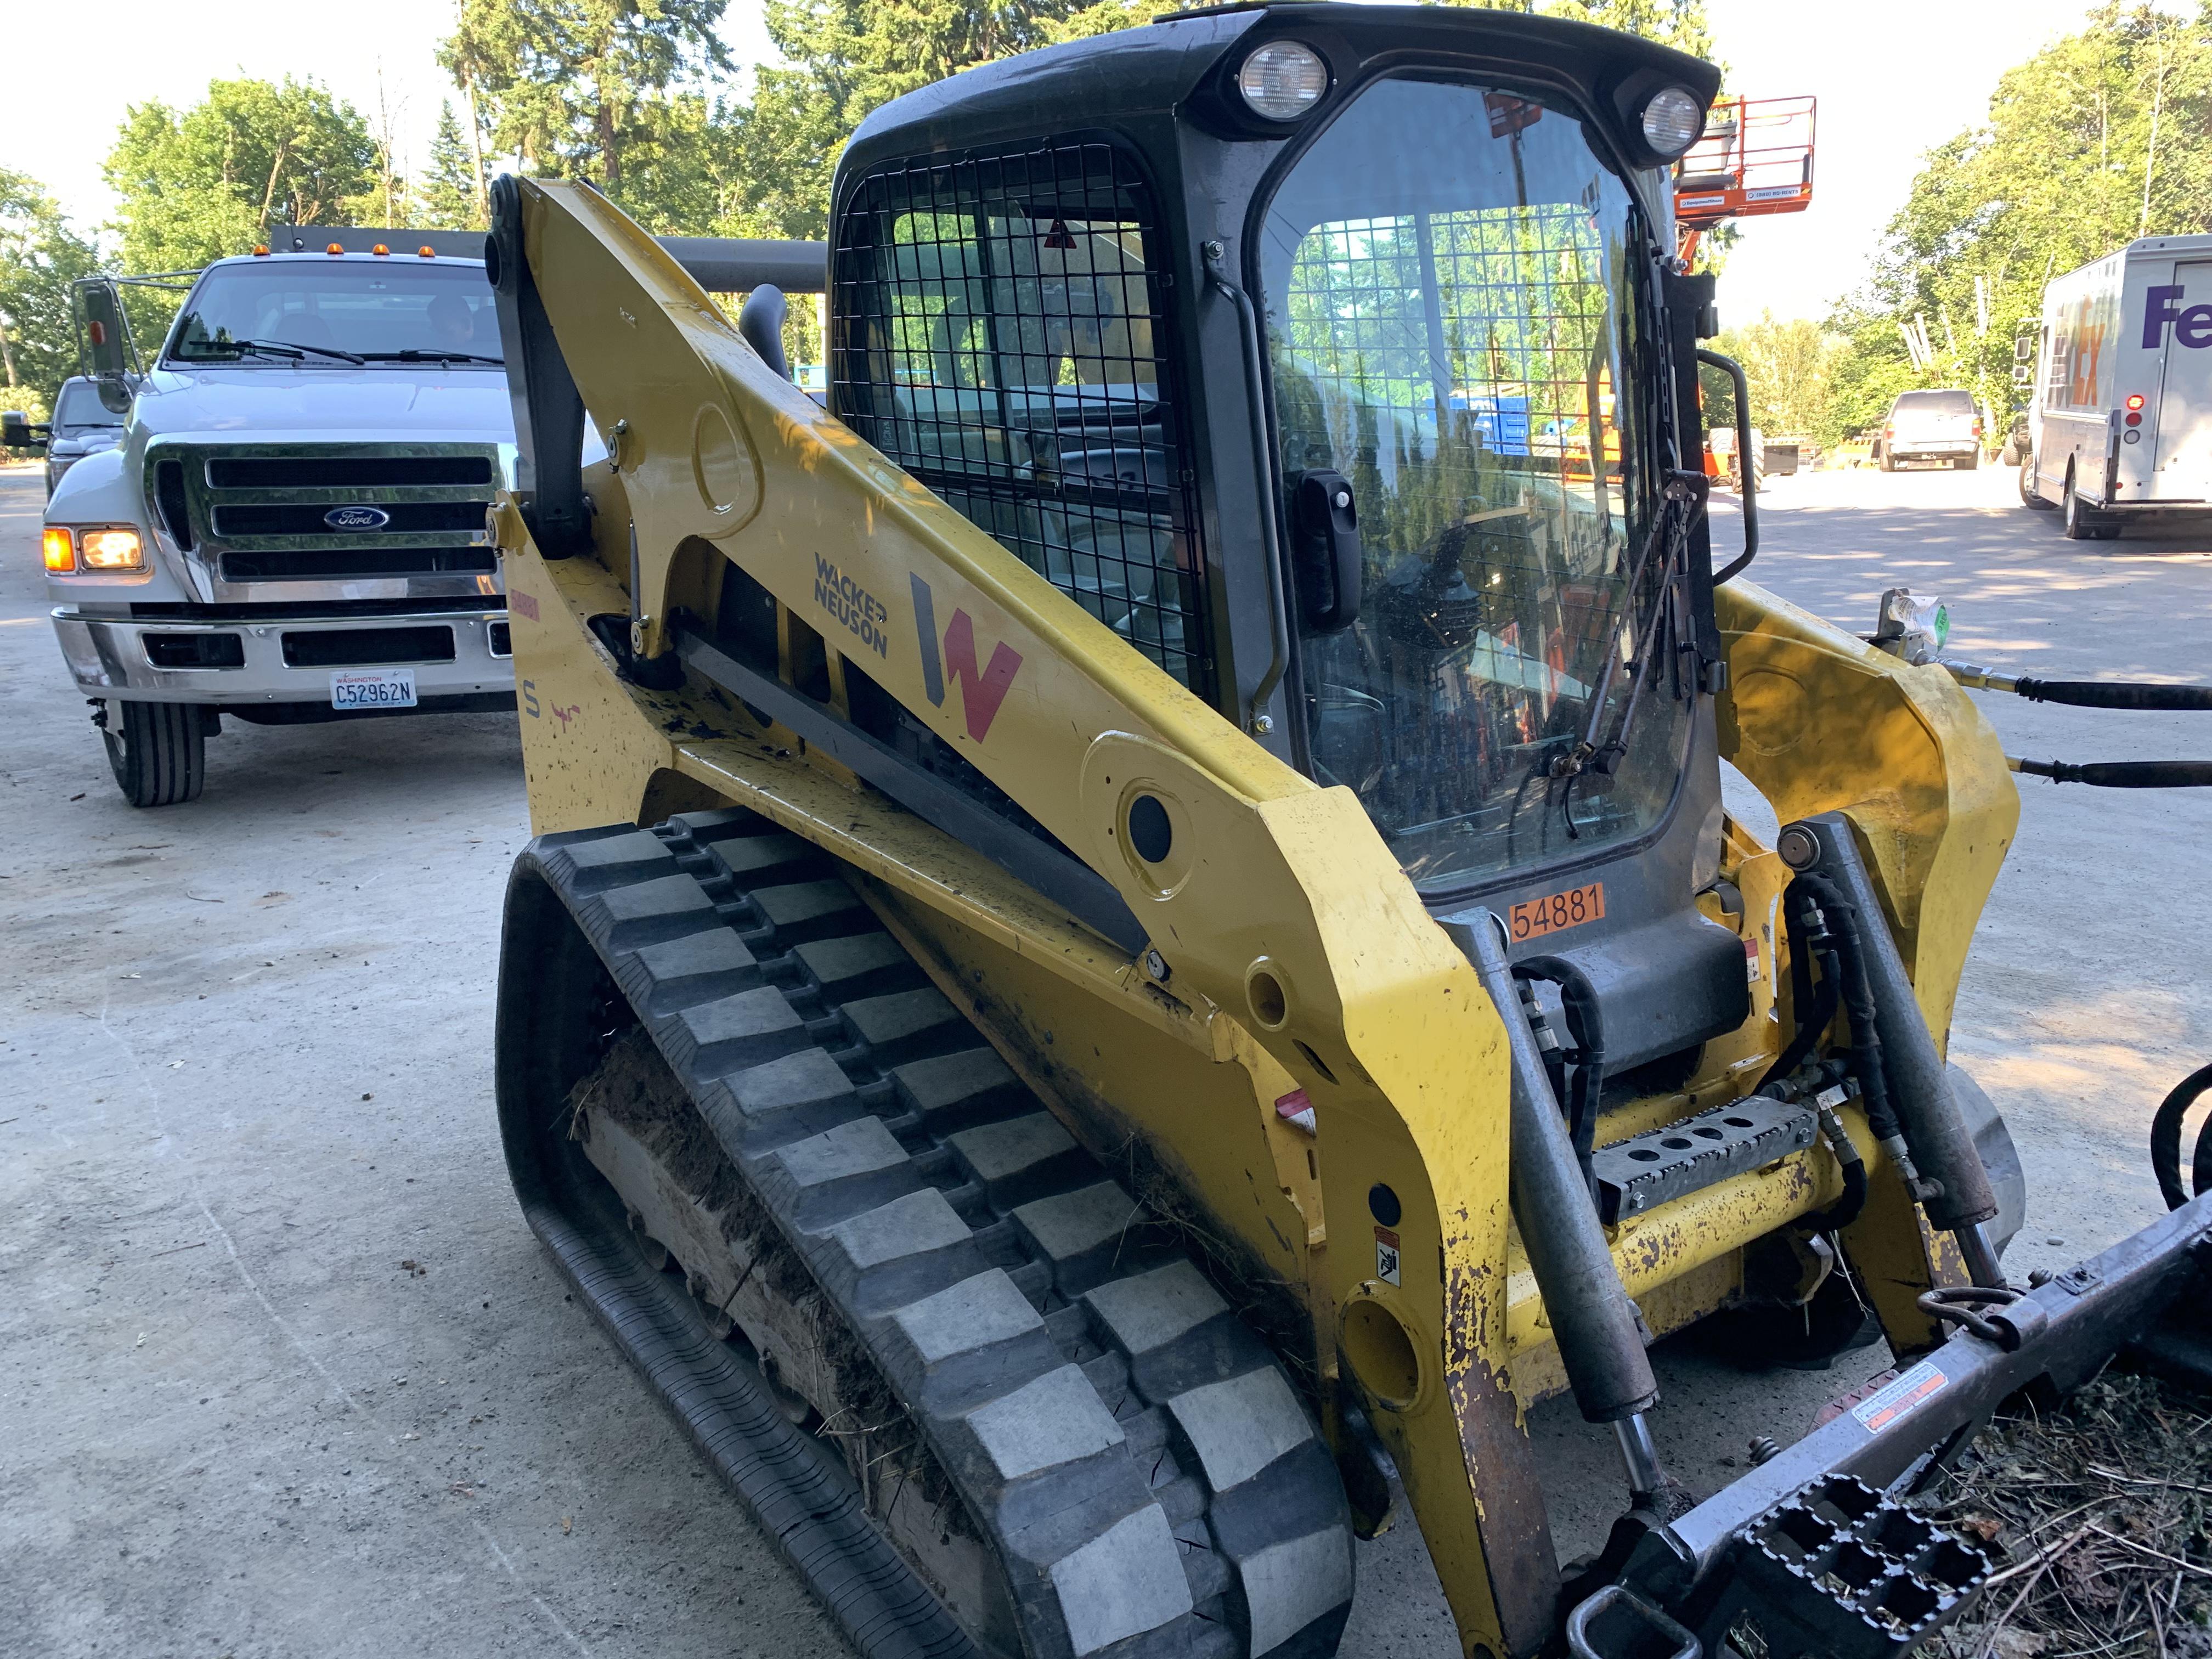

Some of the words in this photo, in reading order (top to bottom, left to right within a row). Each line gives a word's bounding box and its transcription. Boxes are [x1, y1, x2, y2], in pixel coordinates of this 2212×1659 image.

[338, 511, 373, 524] Ford
[814, 579, 888, 659] NEUSON
[336, 682, 410, 703] C52962N
[1514, 884, 1599, 938] 54881
